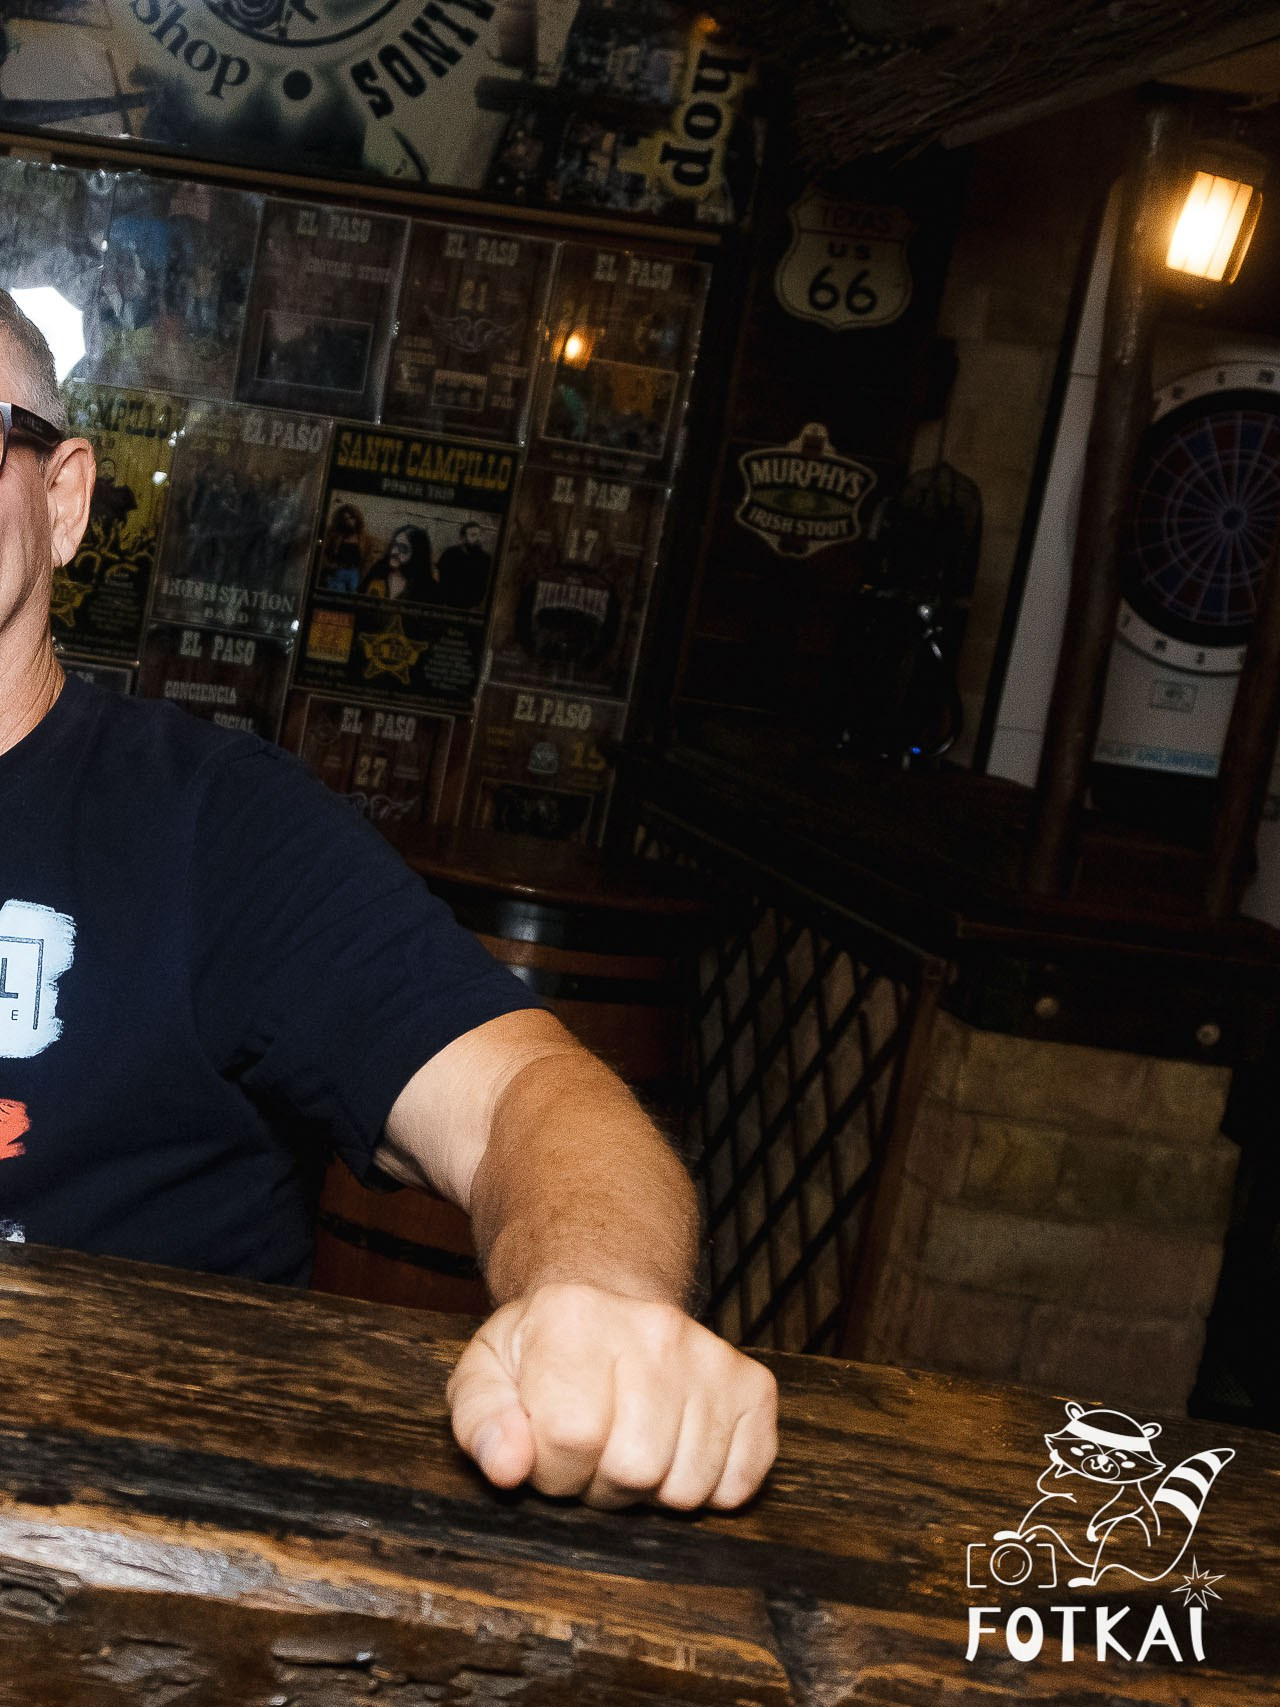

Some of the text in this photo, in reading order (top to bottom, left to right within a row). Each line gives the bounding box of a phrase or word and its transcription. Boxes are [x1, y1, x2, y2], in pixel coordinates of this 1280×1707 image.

[296, 209, 372, 244] EL PASO
[820, 206, 893, 235] TEXAS
[443, 231, 521, 268] EL PASO
[592, 253, 675, 292] EL PASO
[808, 265, 878, 316] 66
[270, 418, 324, 454] PASO
[335, 430, 403, 475] SANTI
[405, 441, 513, 492] CAMPILLO
[551, 475, 633, 512] EL PASO
[747, 508, 851, 539] IRISH STOUT
[219, 582, 297, 613] STATION
[178, 629, 257, 666] EL PASO
[340, 706, 418, 742] EL PASO
[513, 693, 594, 732] EL PASO
[354, 753, 388, 788] 27
